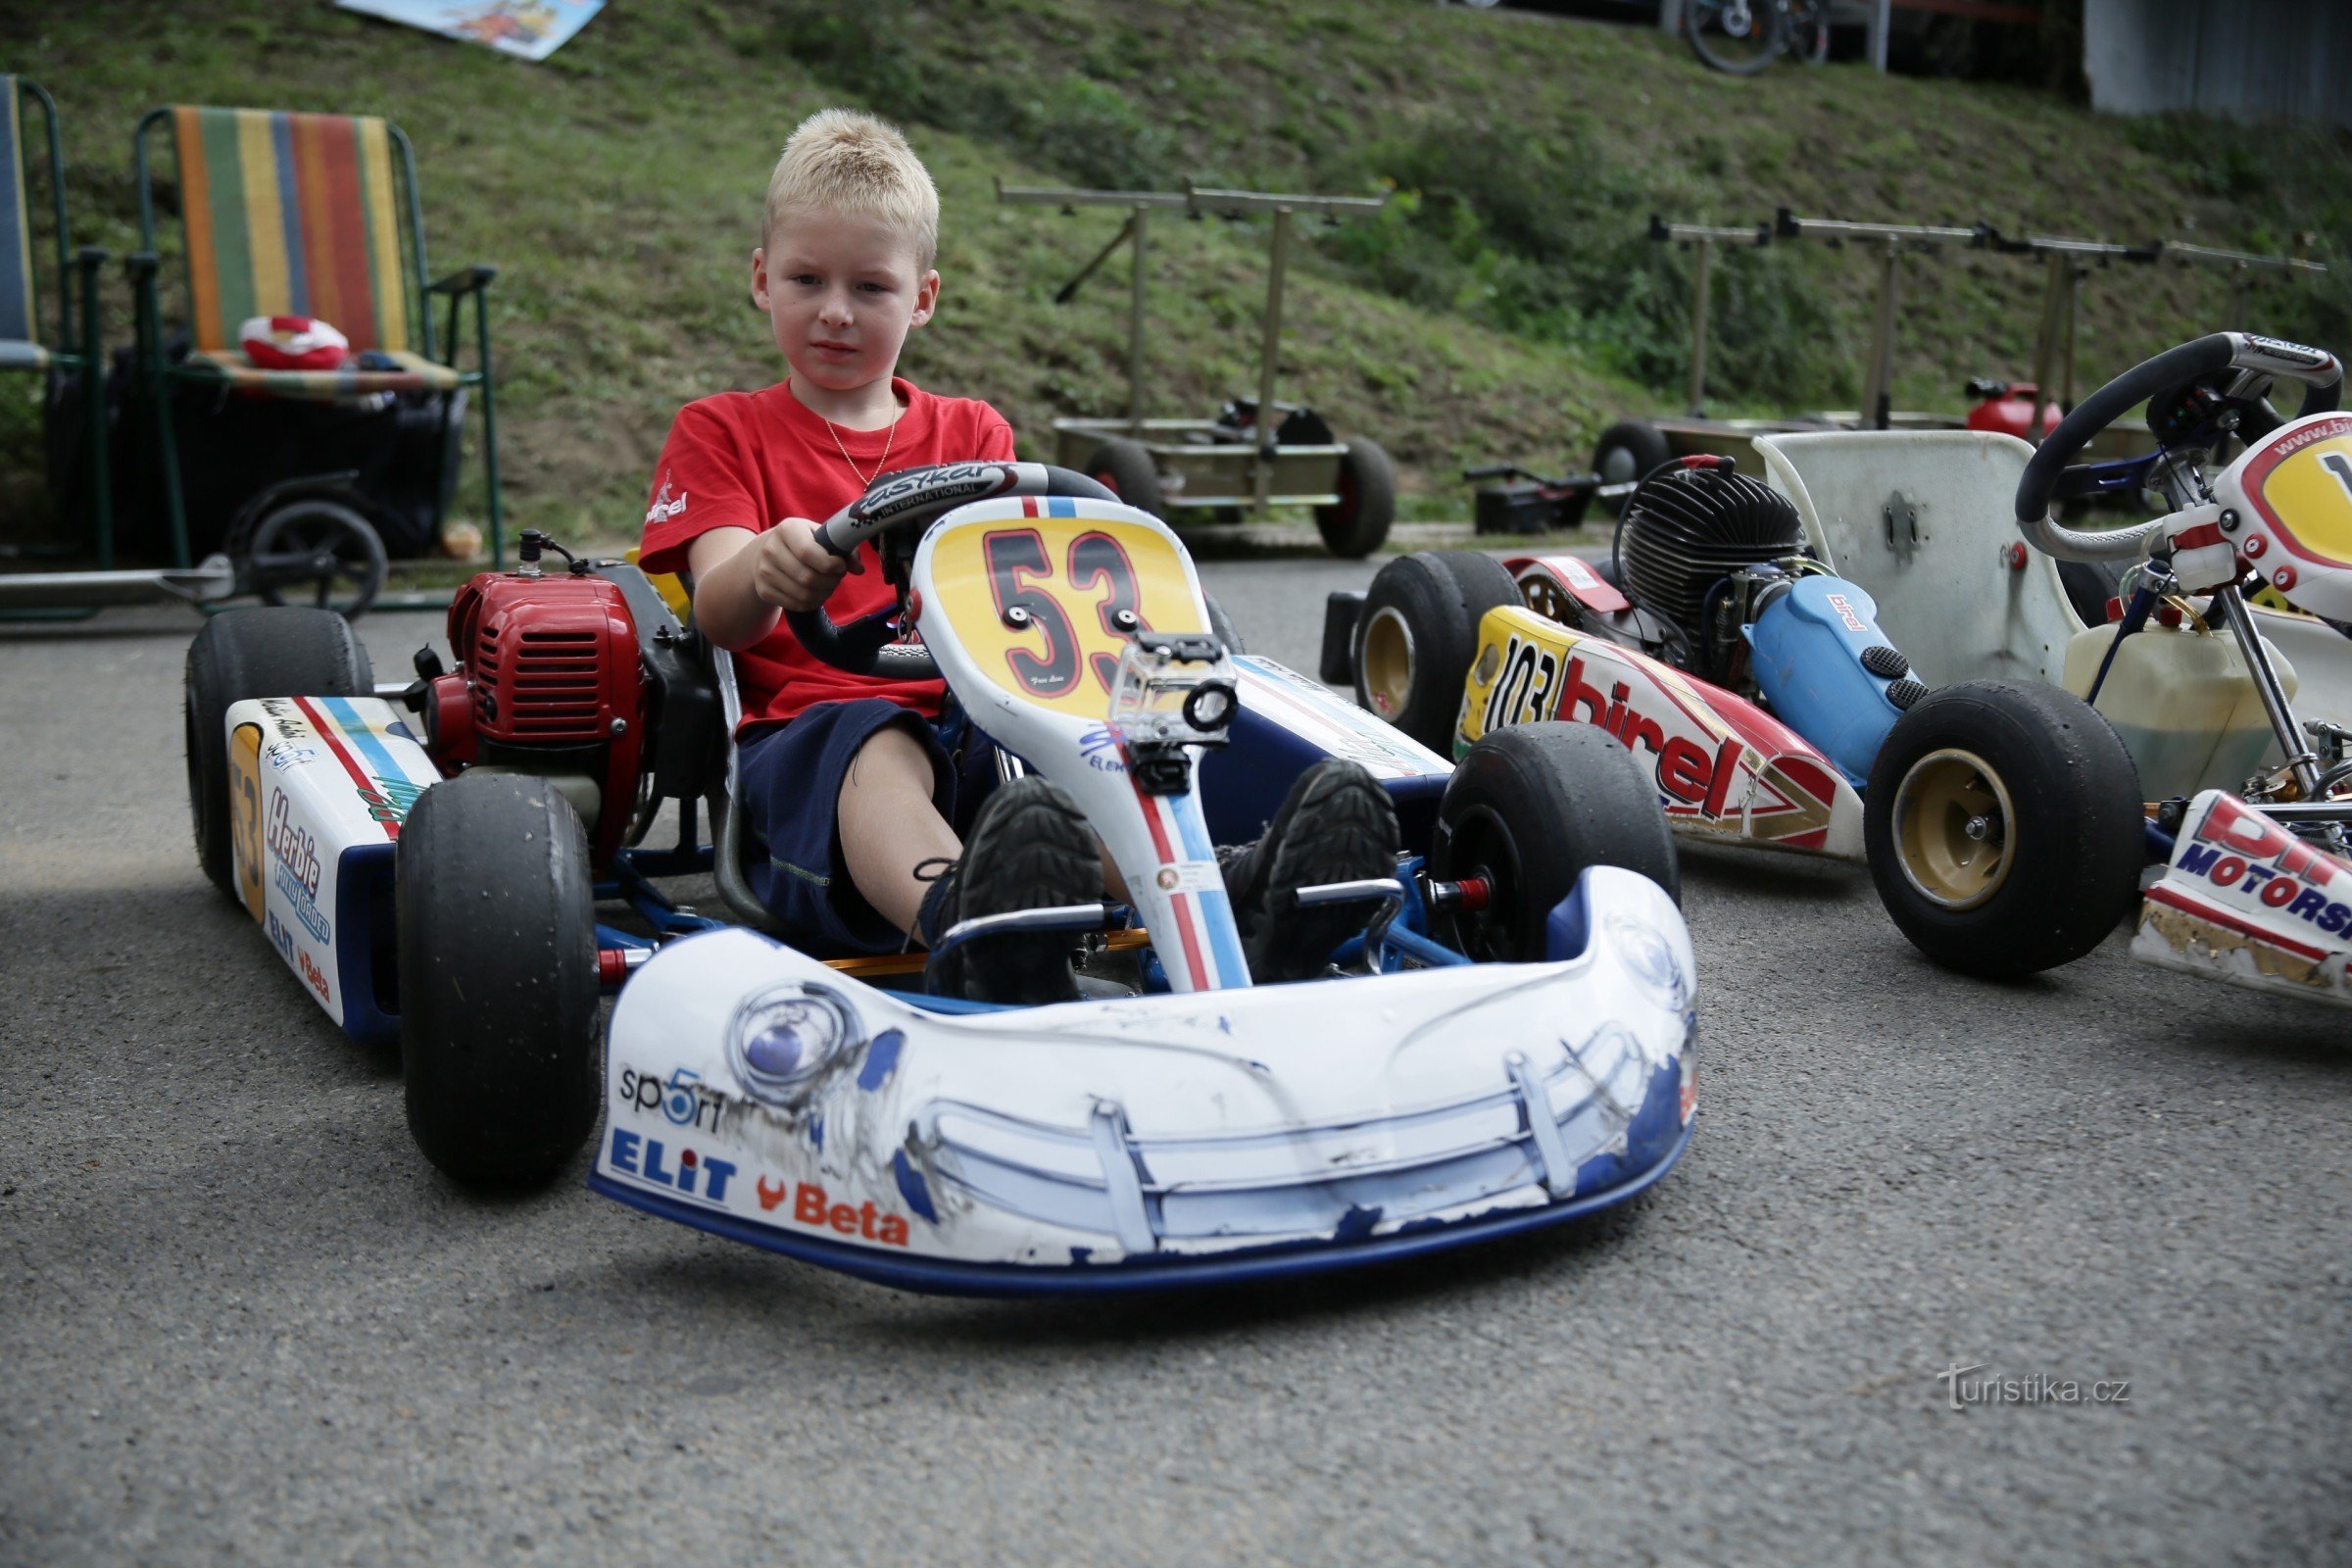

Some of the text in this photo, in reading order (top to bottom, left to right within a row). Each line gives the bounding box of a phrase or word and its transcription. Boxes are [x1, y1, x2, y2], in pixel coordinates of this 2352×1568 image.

[2274, 419, 2352, 456] www.bi
[880, 482, 978, 518] INTERNATIONAL
[983, 527, 1162, 702] 53
[1827, 594, 1868, 632] birel
[1484, 634, 1558, 734] 103
[1552, 654, 1744, 821] birel
[267, 785, 321, 900] Herbie
[794, 1182, 909, 1247] Beta
